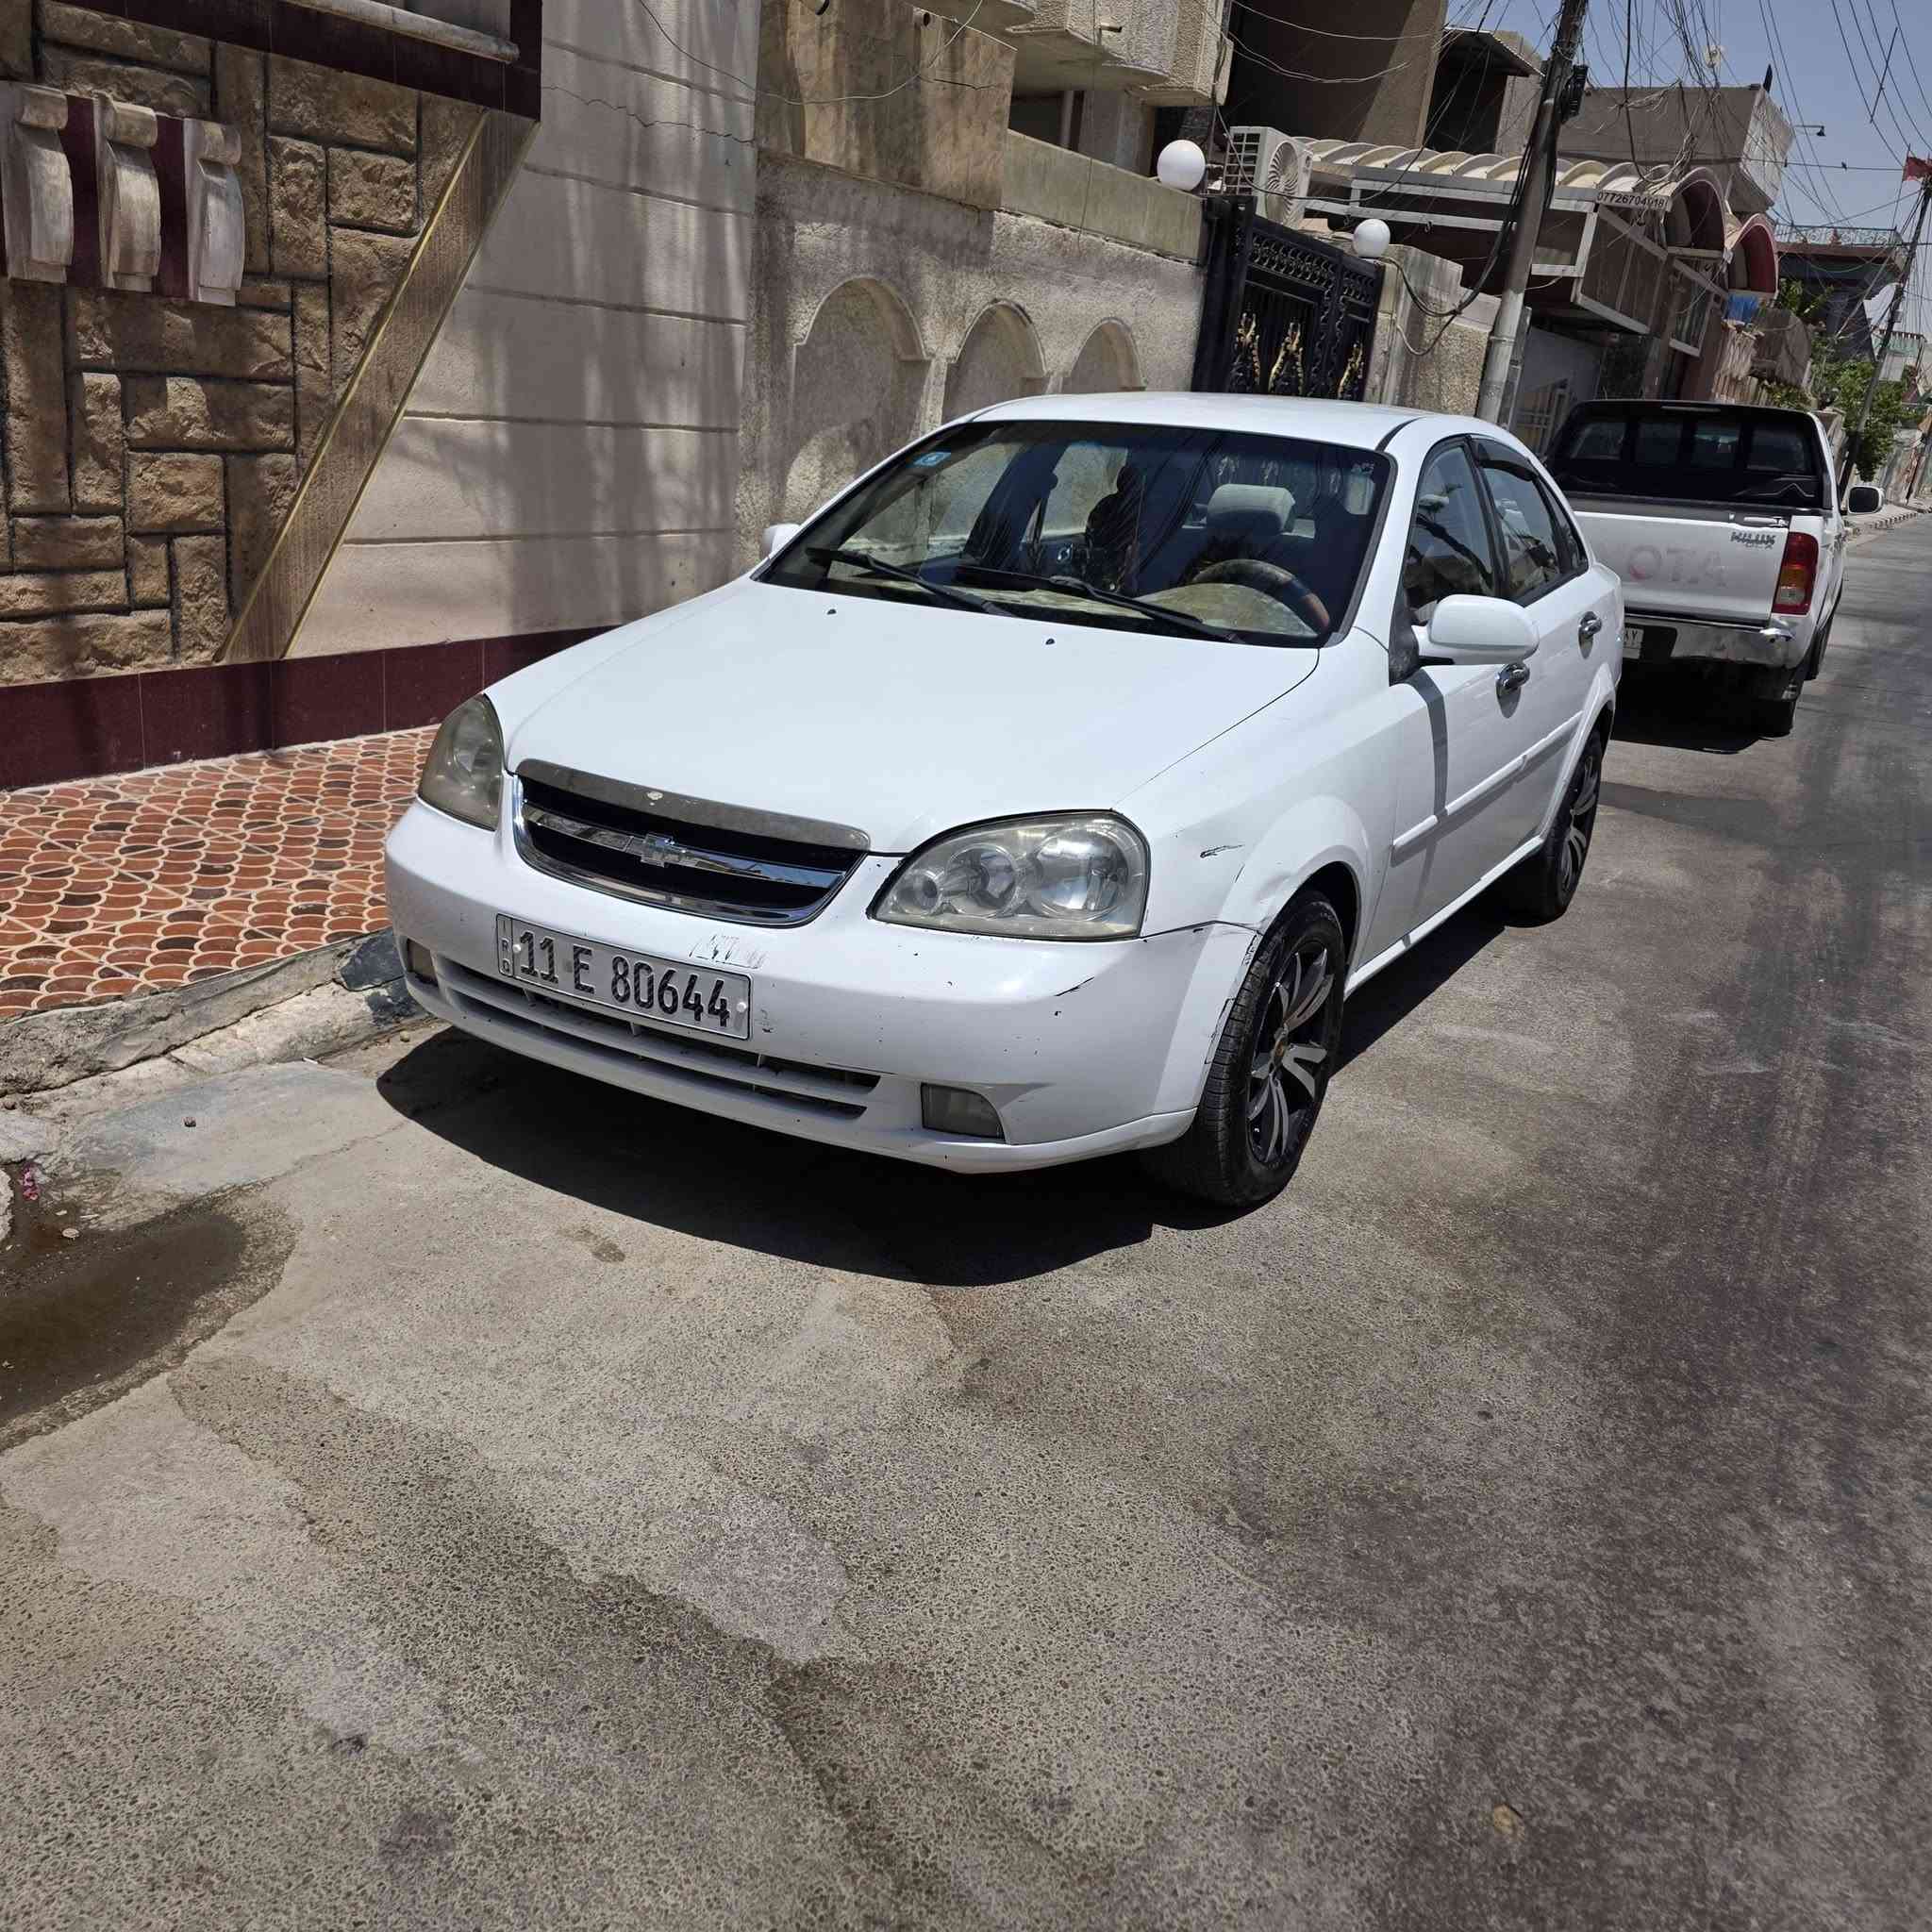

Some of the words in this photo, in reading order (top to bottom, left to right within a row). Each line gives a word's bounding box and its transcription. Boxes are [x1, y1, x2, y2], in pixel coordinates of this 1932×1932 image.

[520, 931, 558, 983] 11
[573, 944, 594, 994] E
[611, 955, 730, 1027] 80644
